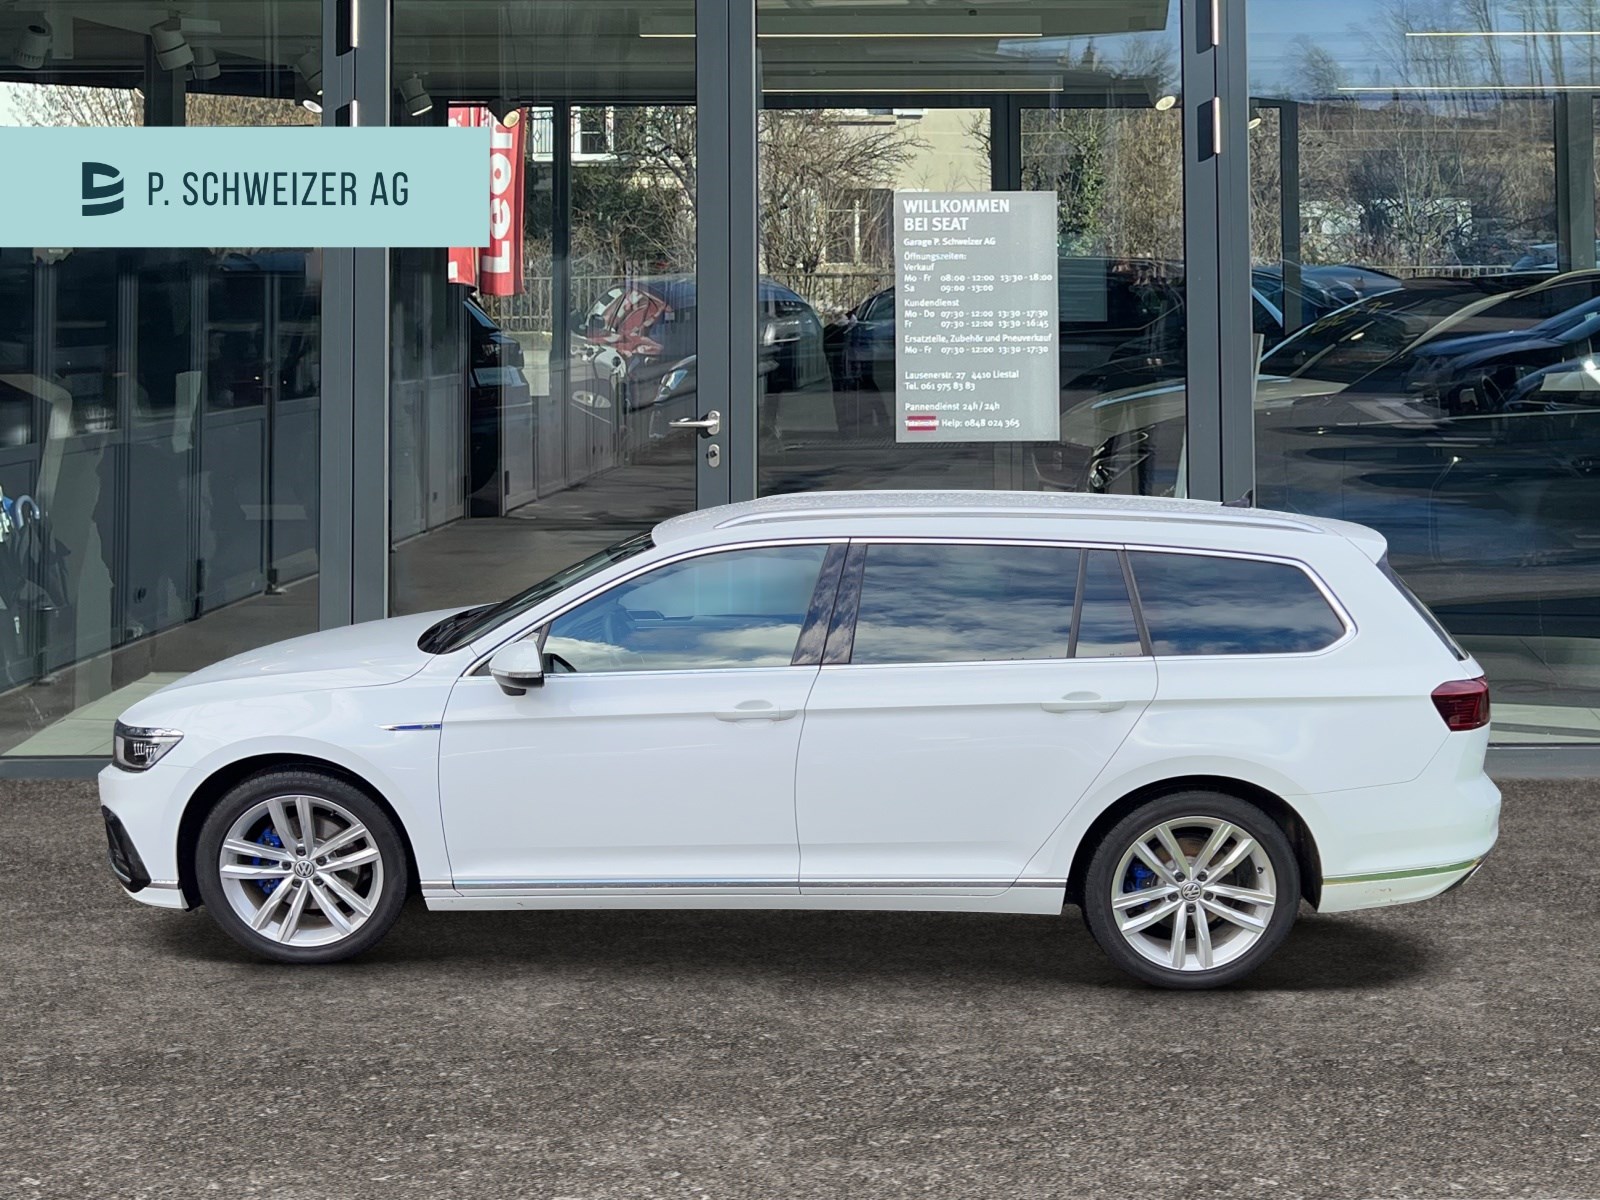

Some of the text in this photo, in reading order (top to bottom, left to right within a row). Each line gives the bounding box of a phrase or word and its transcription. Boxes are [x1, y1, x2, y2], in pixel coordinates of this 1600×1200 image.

[903, 199, 1010, 214] WILLKOMMEN
[903, 217, 969, 231] BEI SEAT
[903, 237, 996, 247] Garage P. Schweizer AG
[904, 251, 967, 262] Öffnungszeiten:
[904, 263, 934, 271] Verkauf
[940, 274, 965, 282] 08:00
[1000, 274, 1023, 283] 13:30
[940, 285, 965, 293] 09:00
[972, 285, 994, 293] 13:00
[904, 299, 960, 307] Kundendienst
[904, 310, 917, 318] Mo
[999, 310, 1020, 318] 13:30
[1027, 310, 1048, 318] 17:30
[999, 320, 1020, 328] 13:30
[1027, 320, 1049, 328] 16:45
[904, 334, 1052, 343] Ersatzteile, Zubehör und Pneuverkauf
[941, 347, 964, 355] 07:30
[999, 346, 1021, 354] 13:30
[1027, 346, 1048, 354] 17:30
[905, 371, 954, 380] Lausenerstr.
[971, 372, 991, 380] 4410
[993, 370, 1019, 378] Liestal
[905, 382, 919, 390] Tel.
[937, 383, 951, 391] 975
[905, 403, 960, 411] Pannendienst
[962, 402, 978, 411] 24h
[984, 402, 1000, 411] 24h
[941, 418, 962, 428] Help:
[964, 419, 986, 427] 0848
[987, 419, 1003, 427] 024
[1004, 419, 1020, 428] 365
